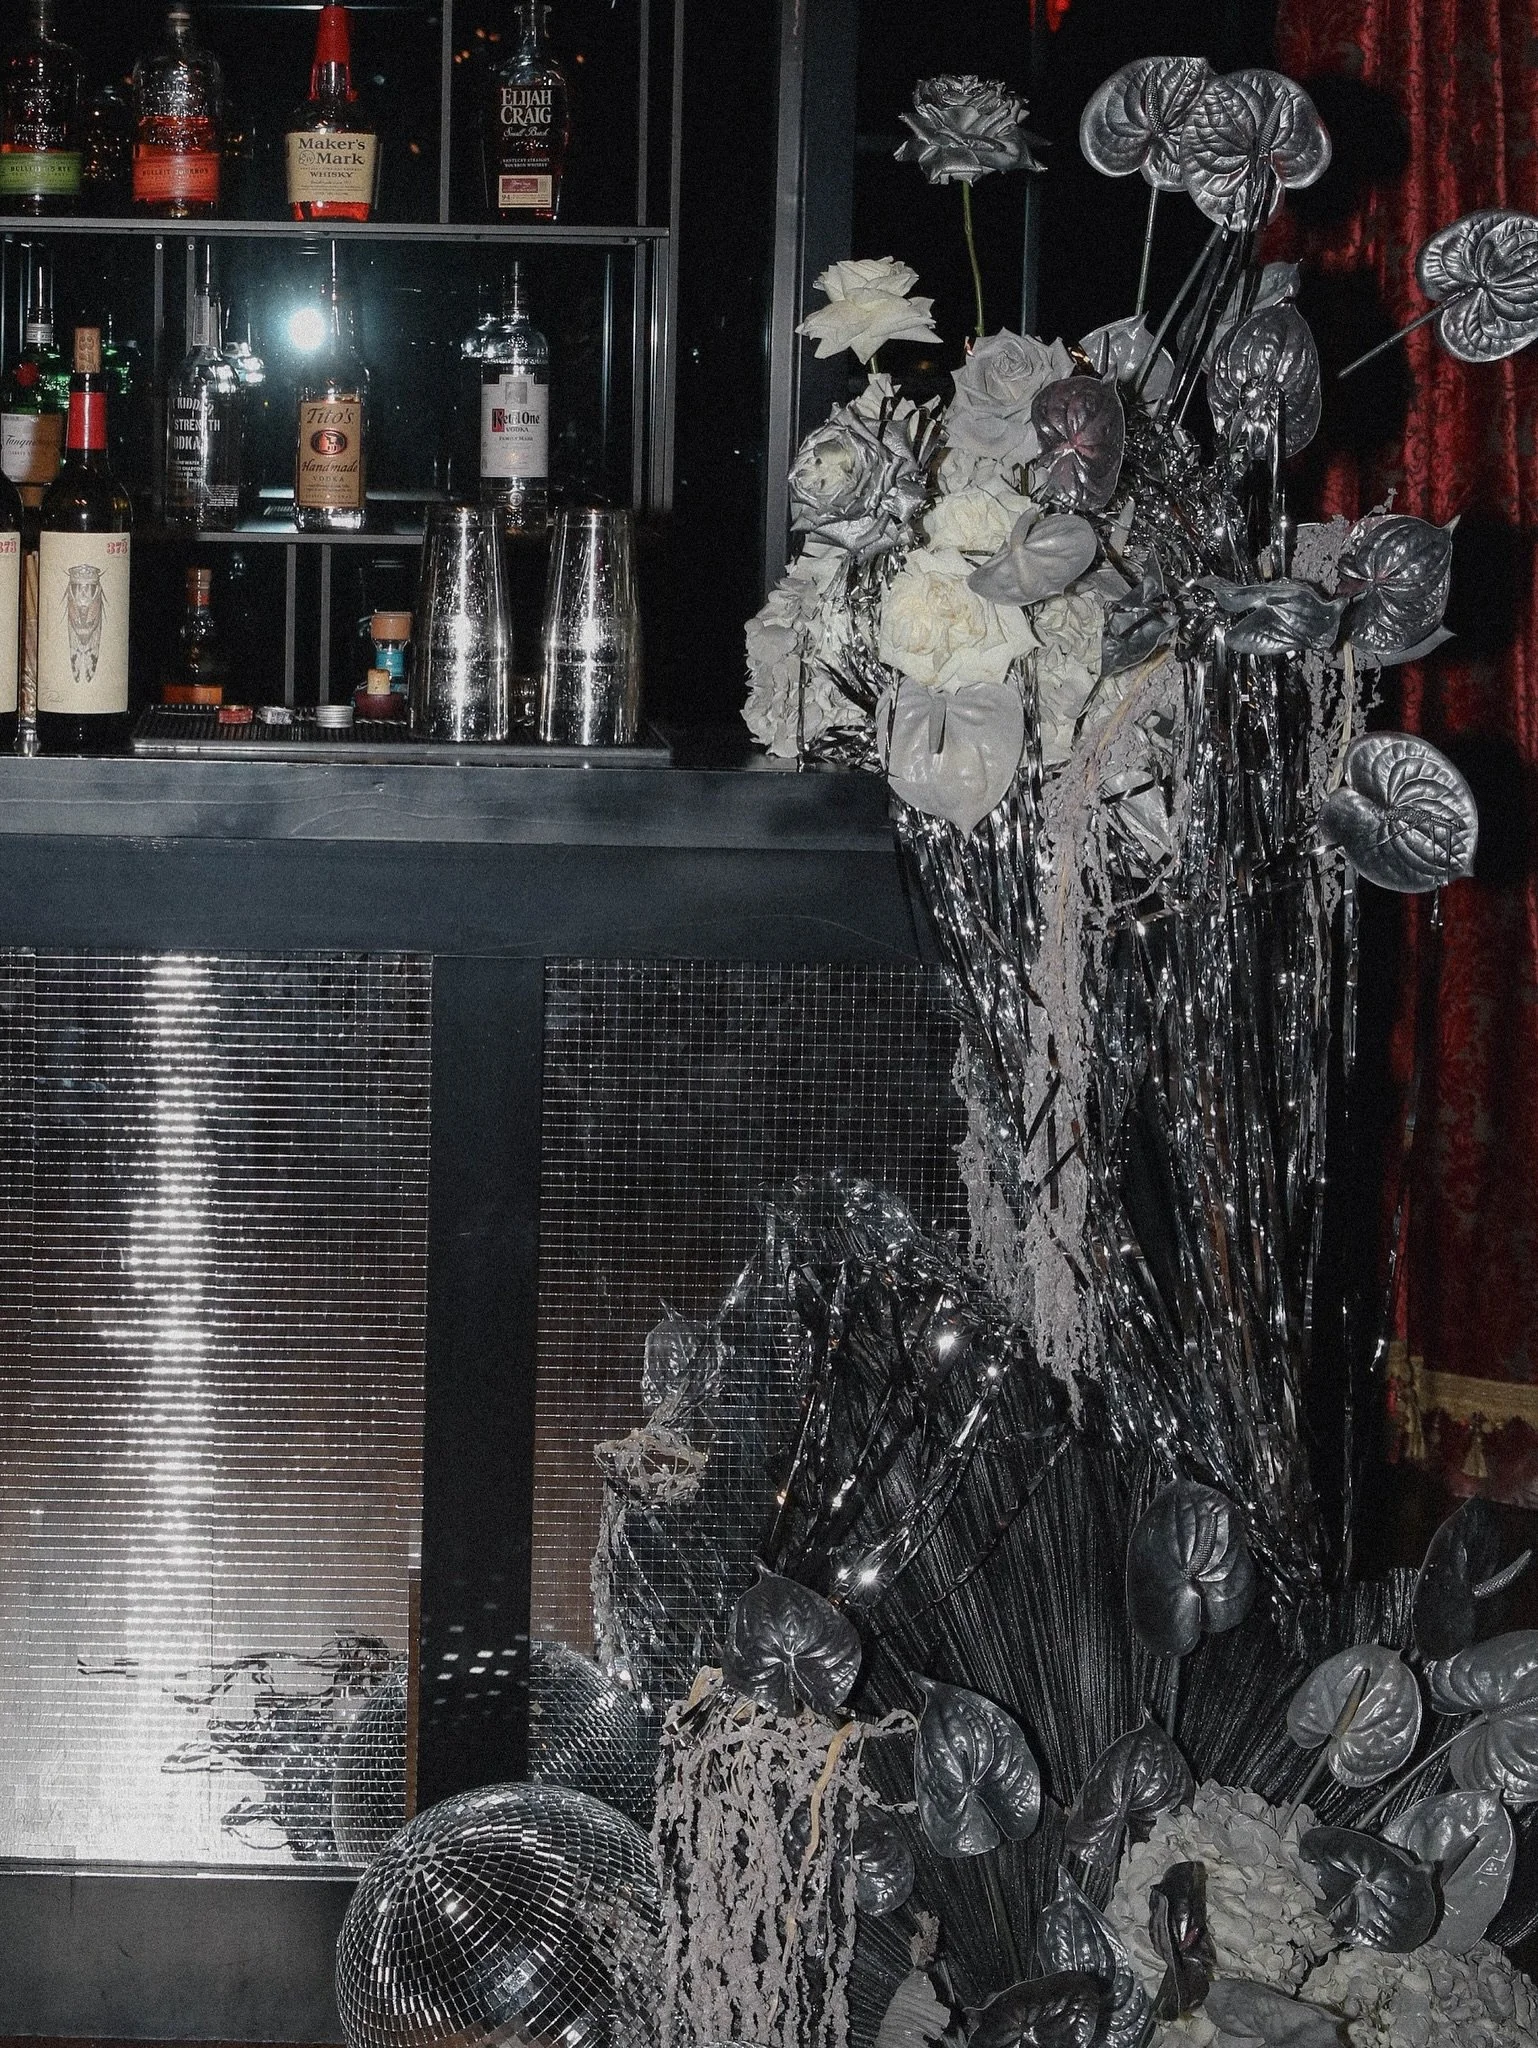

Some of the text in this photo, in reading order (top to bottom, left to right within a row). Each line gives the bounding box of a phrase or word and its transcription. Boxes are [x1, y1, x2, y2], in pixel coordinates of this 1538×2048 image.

[501, 87, 552, 109] ELIJAH
[501, 105, 551, 126] CRAIG
[298, 138, 365, 150] Maker's
[316, 153, 365, 165] Mark
[307, 408, 355, 425] Tito's
[521, 411, 541, 425] One
[174, 419, 221, 431] STRENTH
[172, 435, 202, 451] ODKA
[301, 459, 358, 473] Handmade
